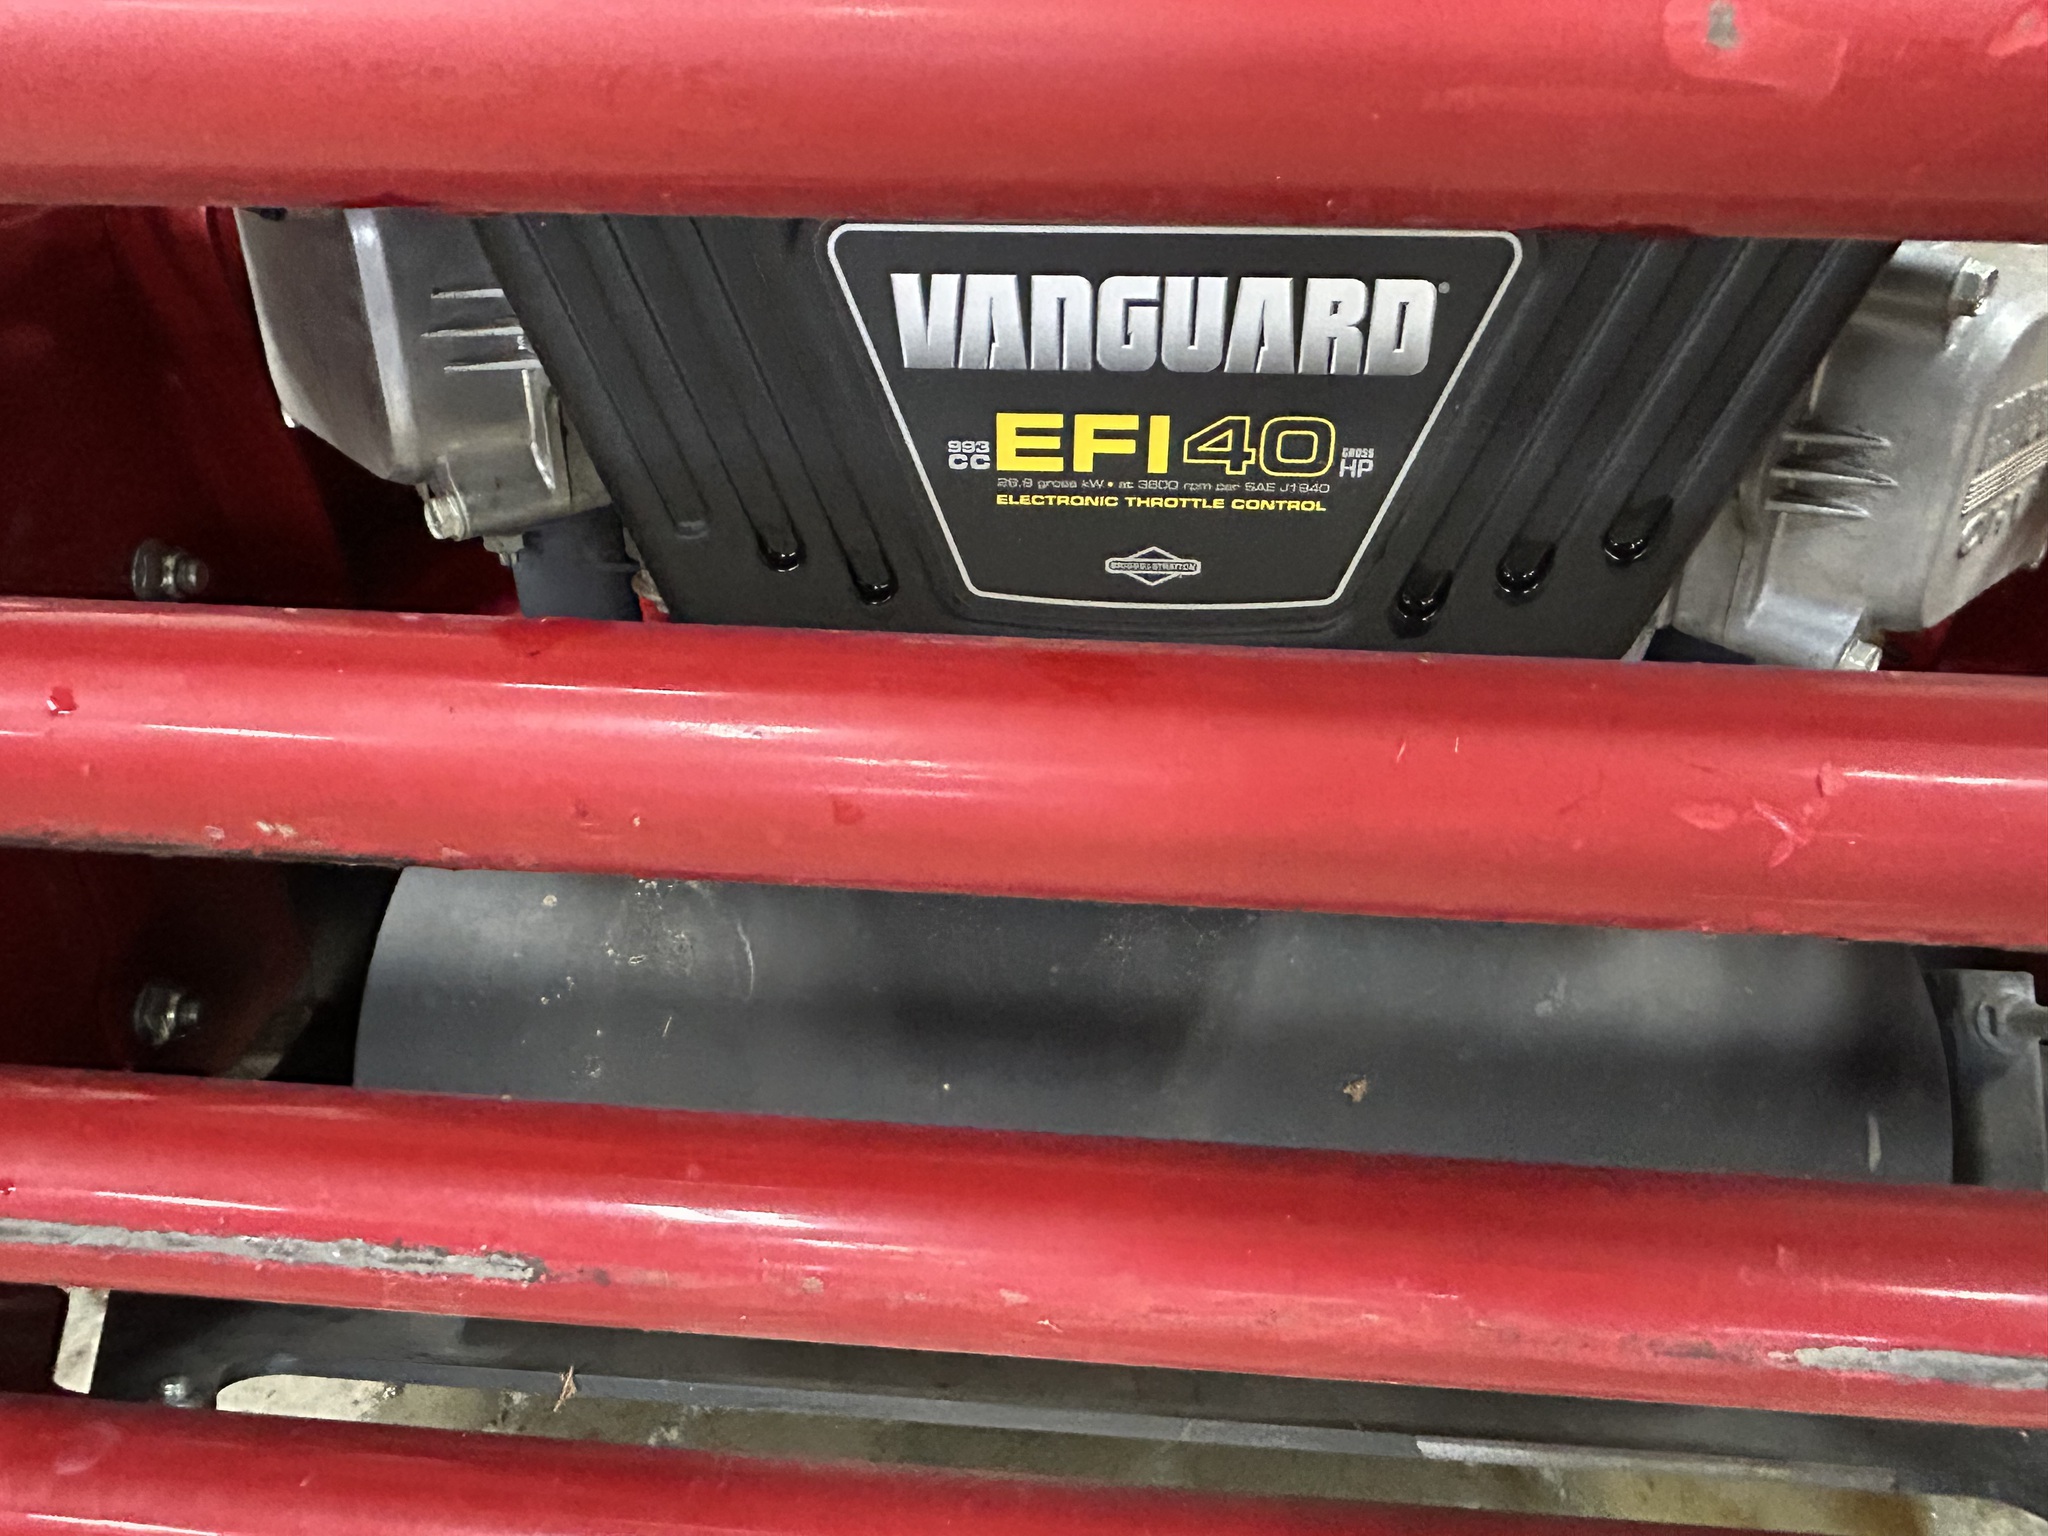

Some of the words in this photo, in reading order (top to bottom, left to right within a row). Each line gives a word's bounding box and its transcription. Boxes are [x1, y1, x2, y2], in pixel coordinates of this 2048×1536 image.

[890, 273, 1437, 376] VANGUARD
[947, 440, 990, 453] 993
[996, 412, 1170, 473] EFI
[1183, 415, 1336, 477] 40
[948, 453, 991, 470] CC
[1339, 459, 1374, 478] HP
[1244, 482, 1276, 493] SAE
[996, 494, 1119, 507] ELECTRONIC
[1124, 496, 1225, 509] THROTTLE
[1230, 498, 1327, 512] CONTROL
